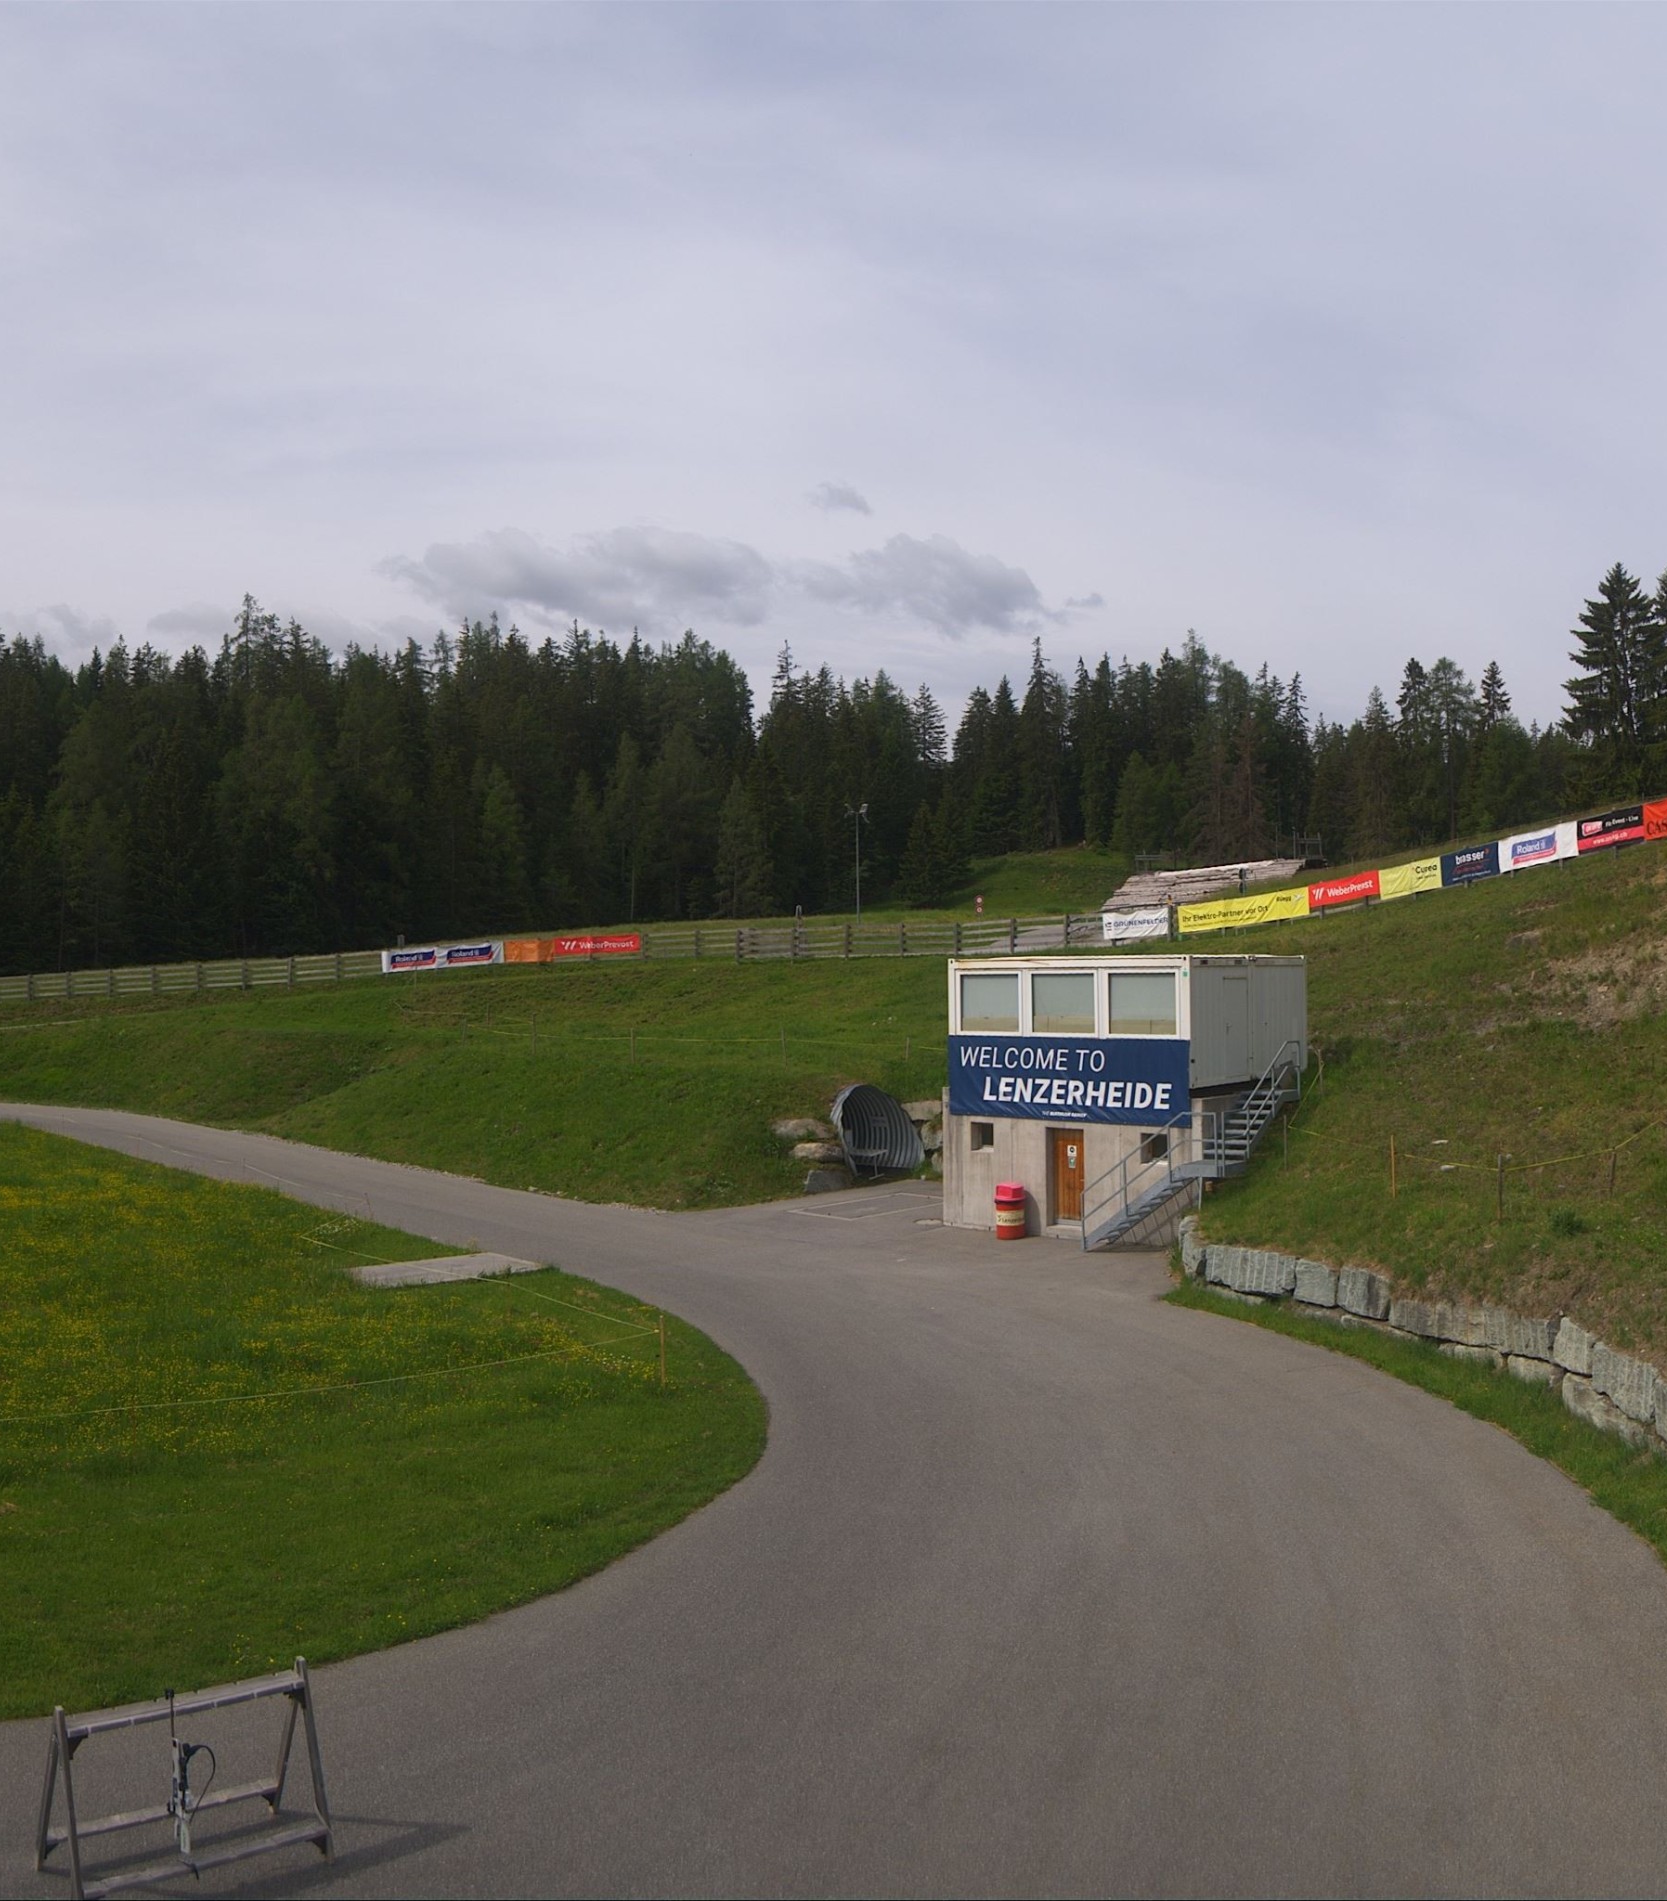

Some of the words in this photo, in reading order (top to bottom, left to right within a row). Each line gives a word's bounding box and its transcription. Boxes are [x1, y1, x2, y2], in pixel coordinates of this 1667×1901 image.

[1516, 842, 1540, 853] Roland
[1415, 863, 1438, 874] Curea
[960, 1046, 1069, 1071] WELCOME
[1075, 1049, 1106, 1072] TO
[982, 1076, 1173, 1110] LENZERHEIDE
